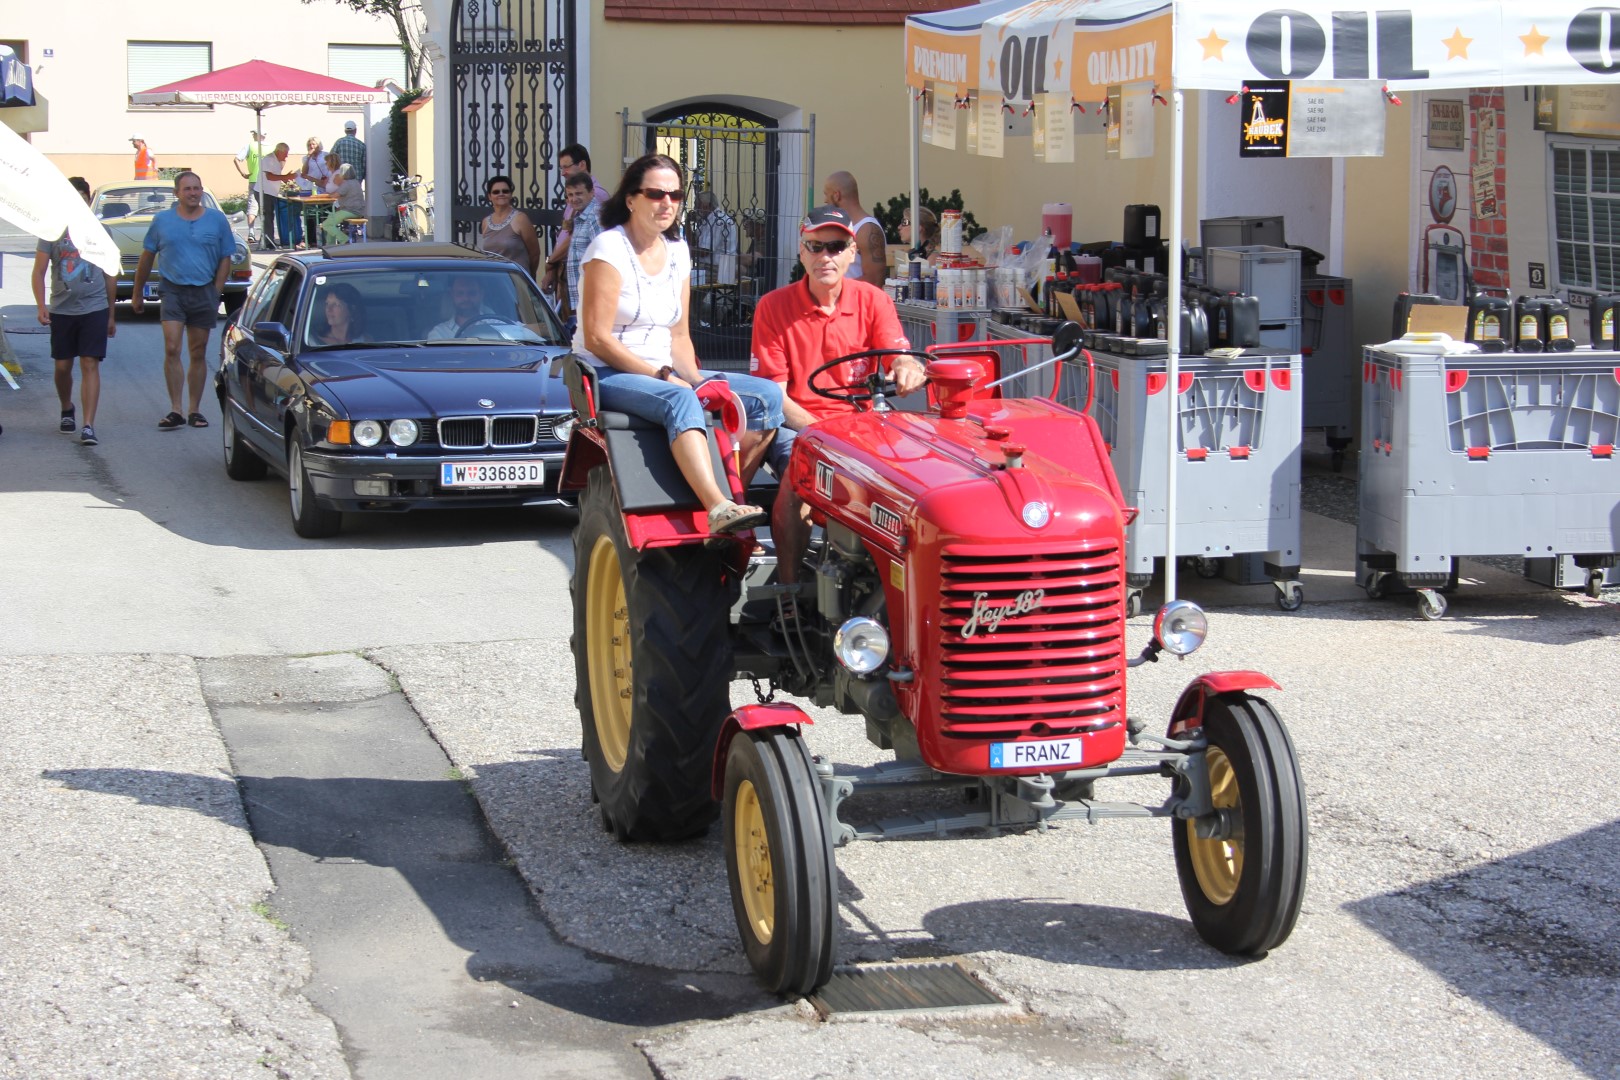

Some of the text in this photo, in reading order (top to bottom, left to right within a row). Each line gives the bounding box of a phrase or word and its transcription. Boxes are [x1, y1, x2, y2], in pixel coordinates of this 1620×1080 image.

[1245, 8, 1430, 80] OIL
[913, 35, 1157, 101] PREMIUM OIL QUALITY
[195, 92, 375, 102] THERMEN KONDITOREI FÜRSTENFELD
[1432, 103, 1460, 119] EN-AR-CO
[1430, 120, 1462, 132] MOTOR OILS
[1571, 294, 1582, 304] 24
[455, 466, 466, 481] W
[877, 509, 899, 535] DIESEL
[1014, 743, 1071, 763] FRANZ
